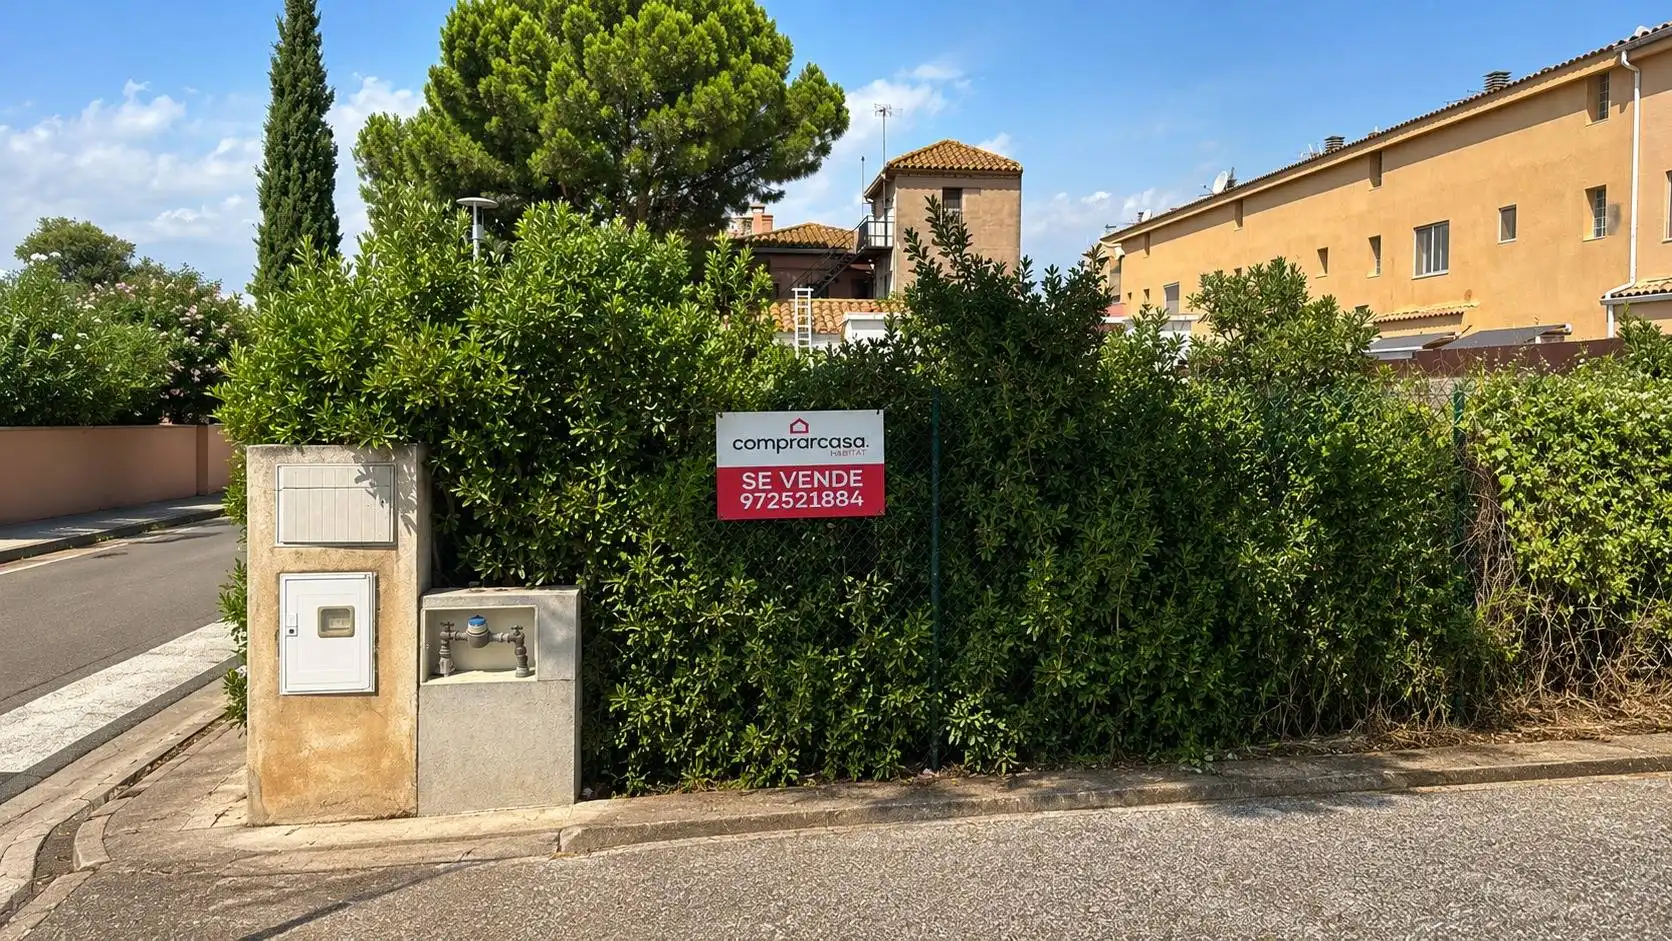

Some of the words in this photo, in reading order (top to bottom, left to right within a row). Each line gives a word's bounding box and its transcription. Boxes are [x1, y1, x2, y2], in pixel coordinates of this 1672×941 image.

[732, 436, 869, 454] comprarcasa.
[830, 449, 867, 457] HABITAT
[742, 471, 772, 490] SE
[780, 469, 863, 489] VENDE
[740, 490, 864, 510] 972521884
